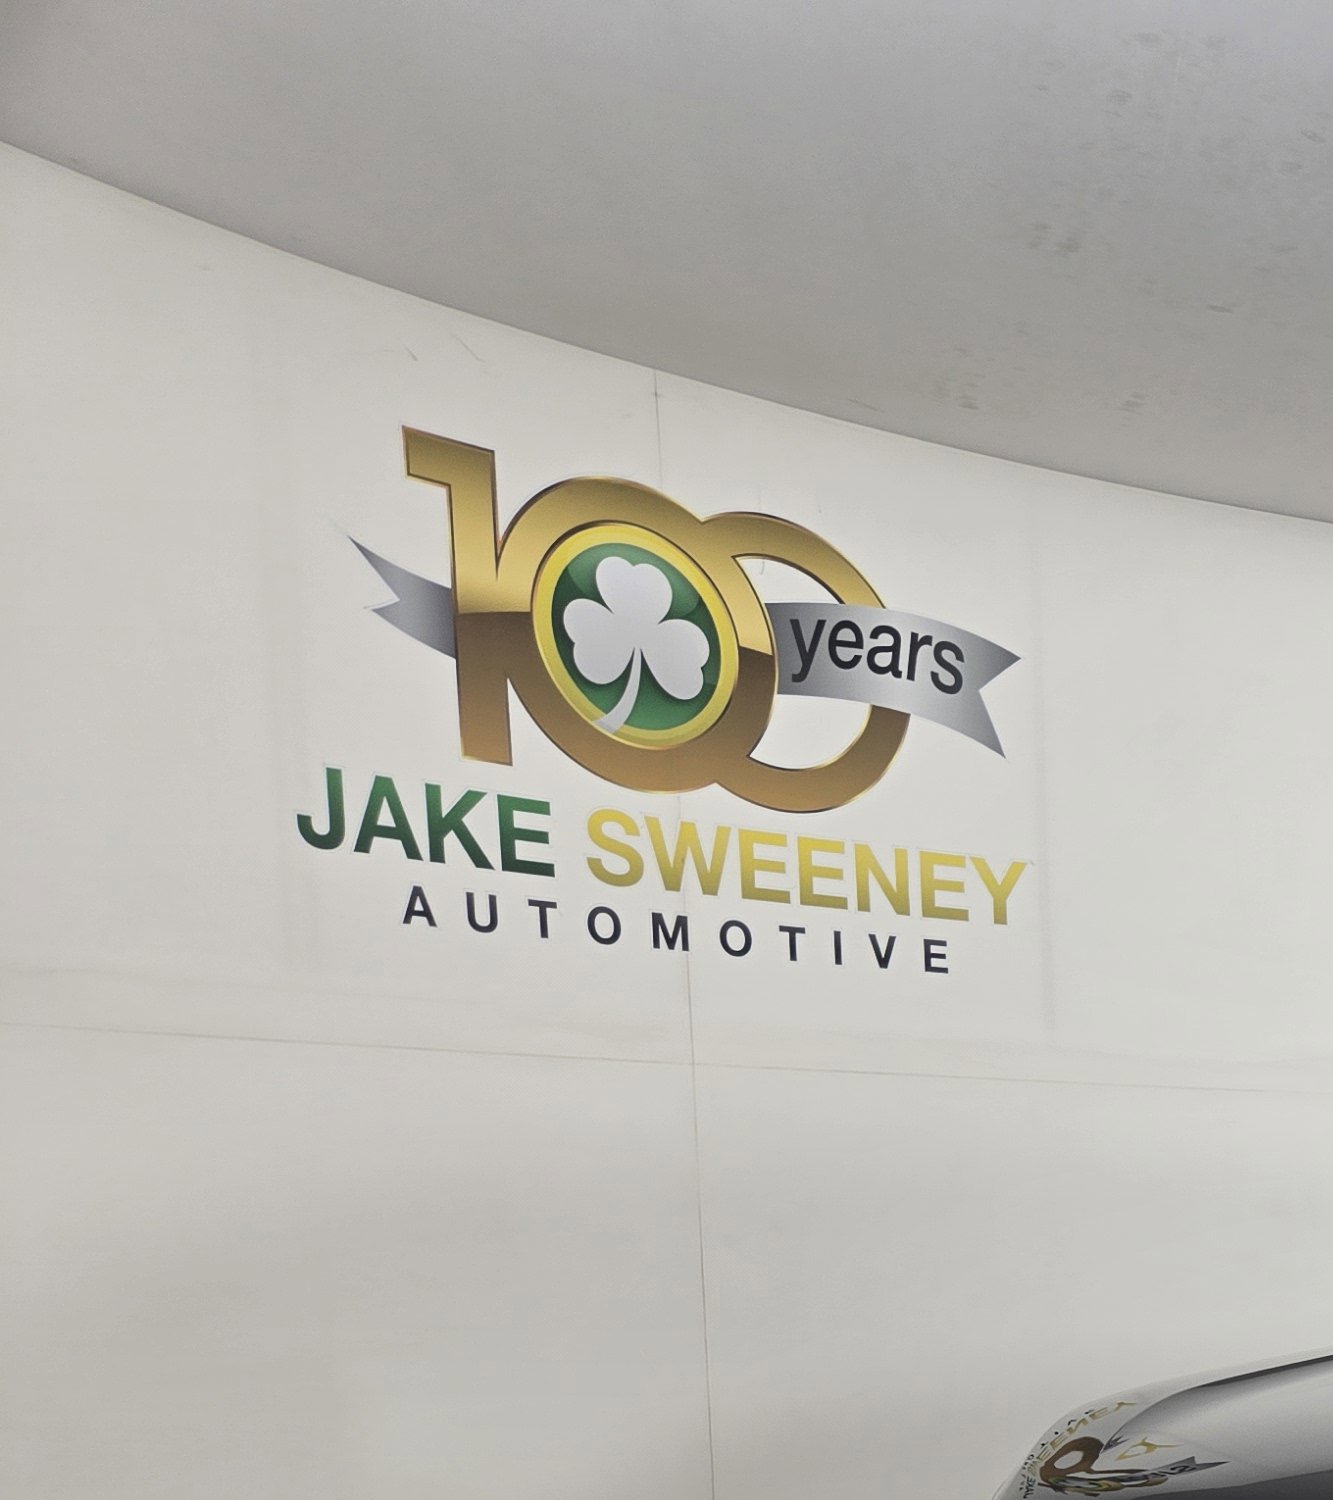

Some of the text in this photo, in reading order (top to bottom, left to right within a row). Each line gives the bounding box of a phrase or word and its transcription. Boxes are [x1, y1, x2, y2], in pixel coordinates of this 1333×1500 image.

[401, 425, 965, 813] 100 years
[296, 766, 1028, 926] JAKE SWEENEY
[402, 885, 949, 974] AUTOMOTIVE
